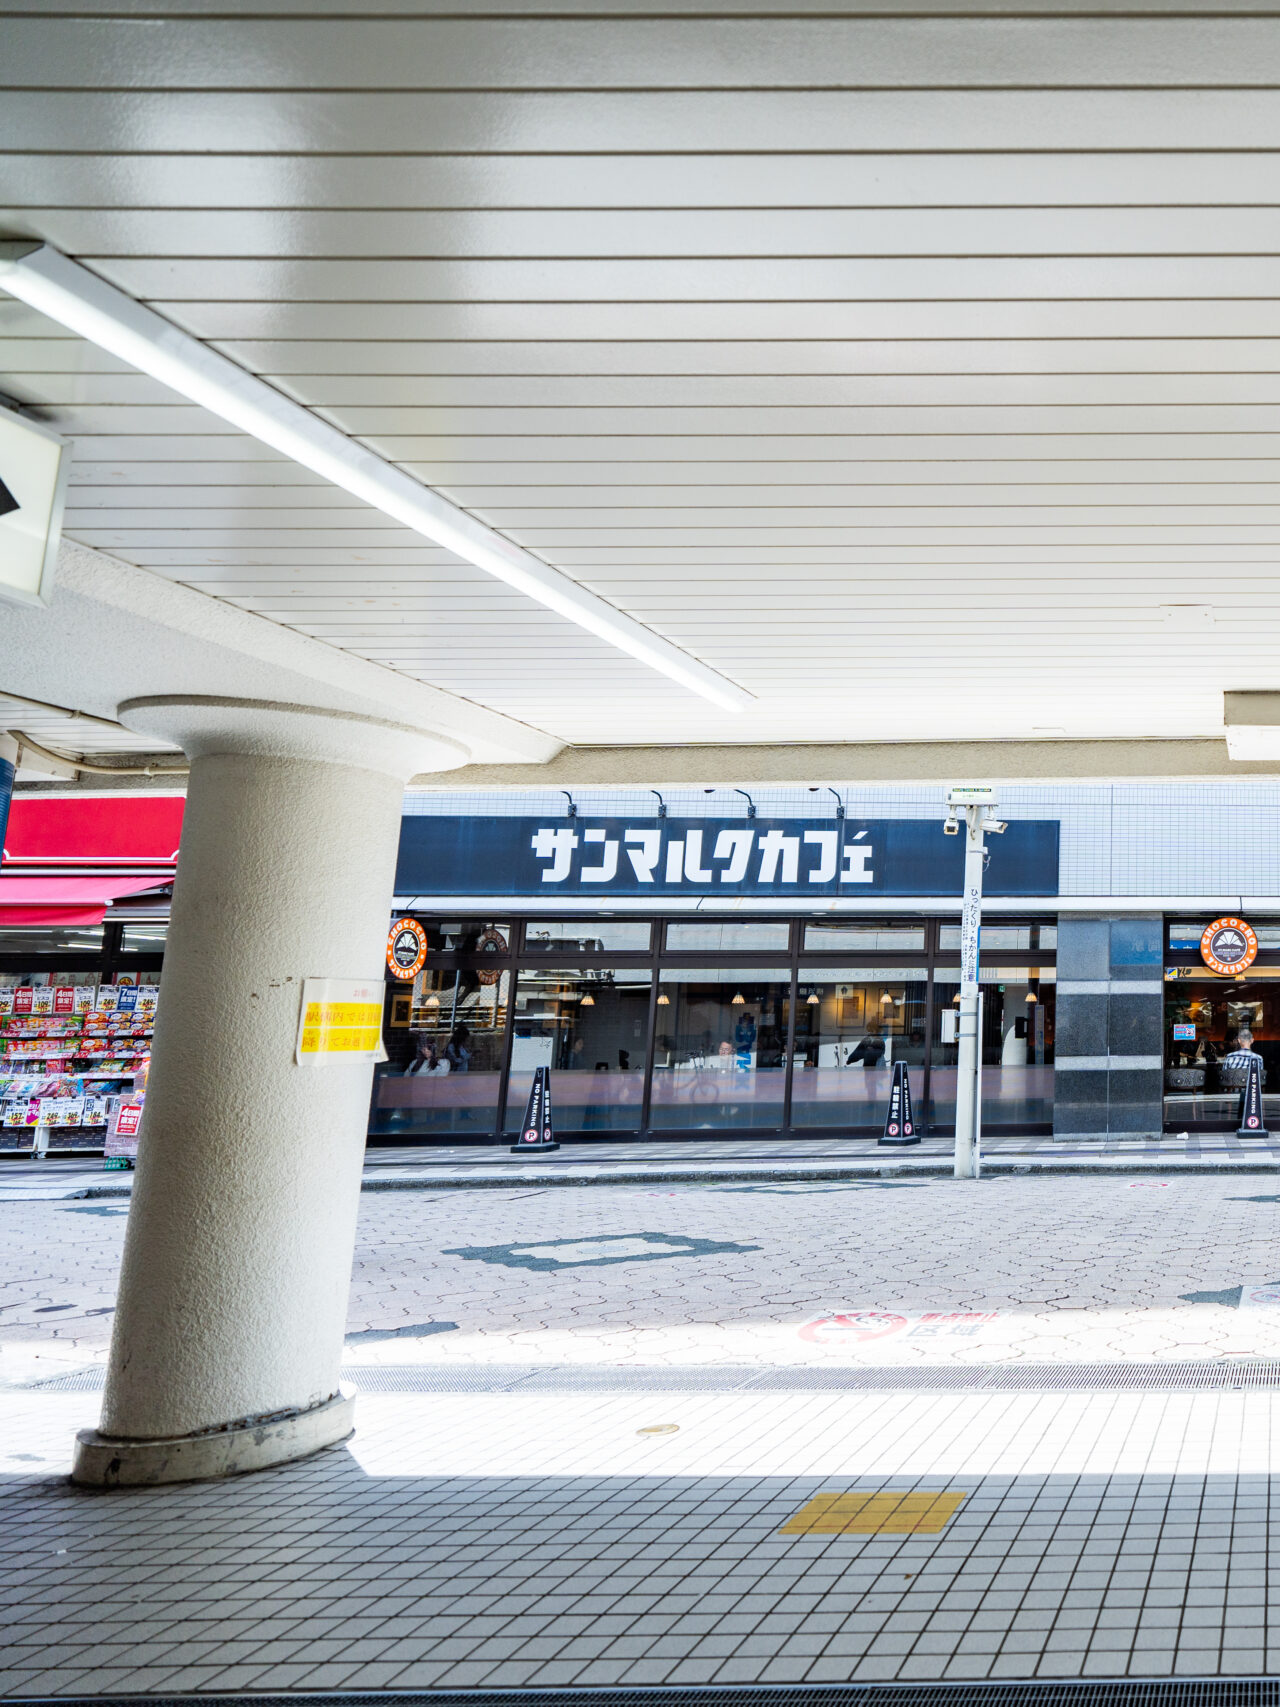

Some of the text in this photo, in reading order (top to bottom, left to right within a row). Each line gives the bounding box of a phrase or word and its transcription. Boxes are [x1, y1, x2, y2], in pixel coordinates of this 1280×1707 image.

[531, 828, 874, 883] サンマルクカフェ
[1202, 918, 1257, 946] CHOCOCRO
[1251, 1073, 1257, 1083] NO
[530, 1083, 541, 1127] NO PARKING
